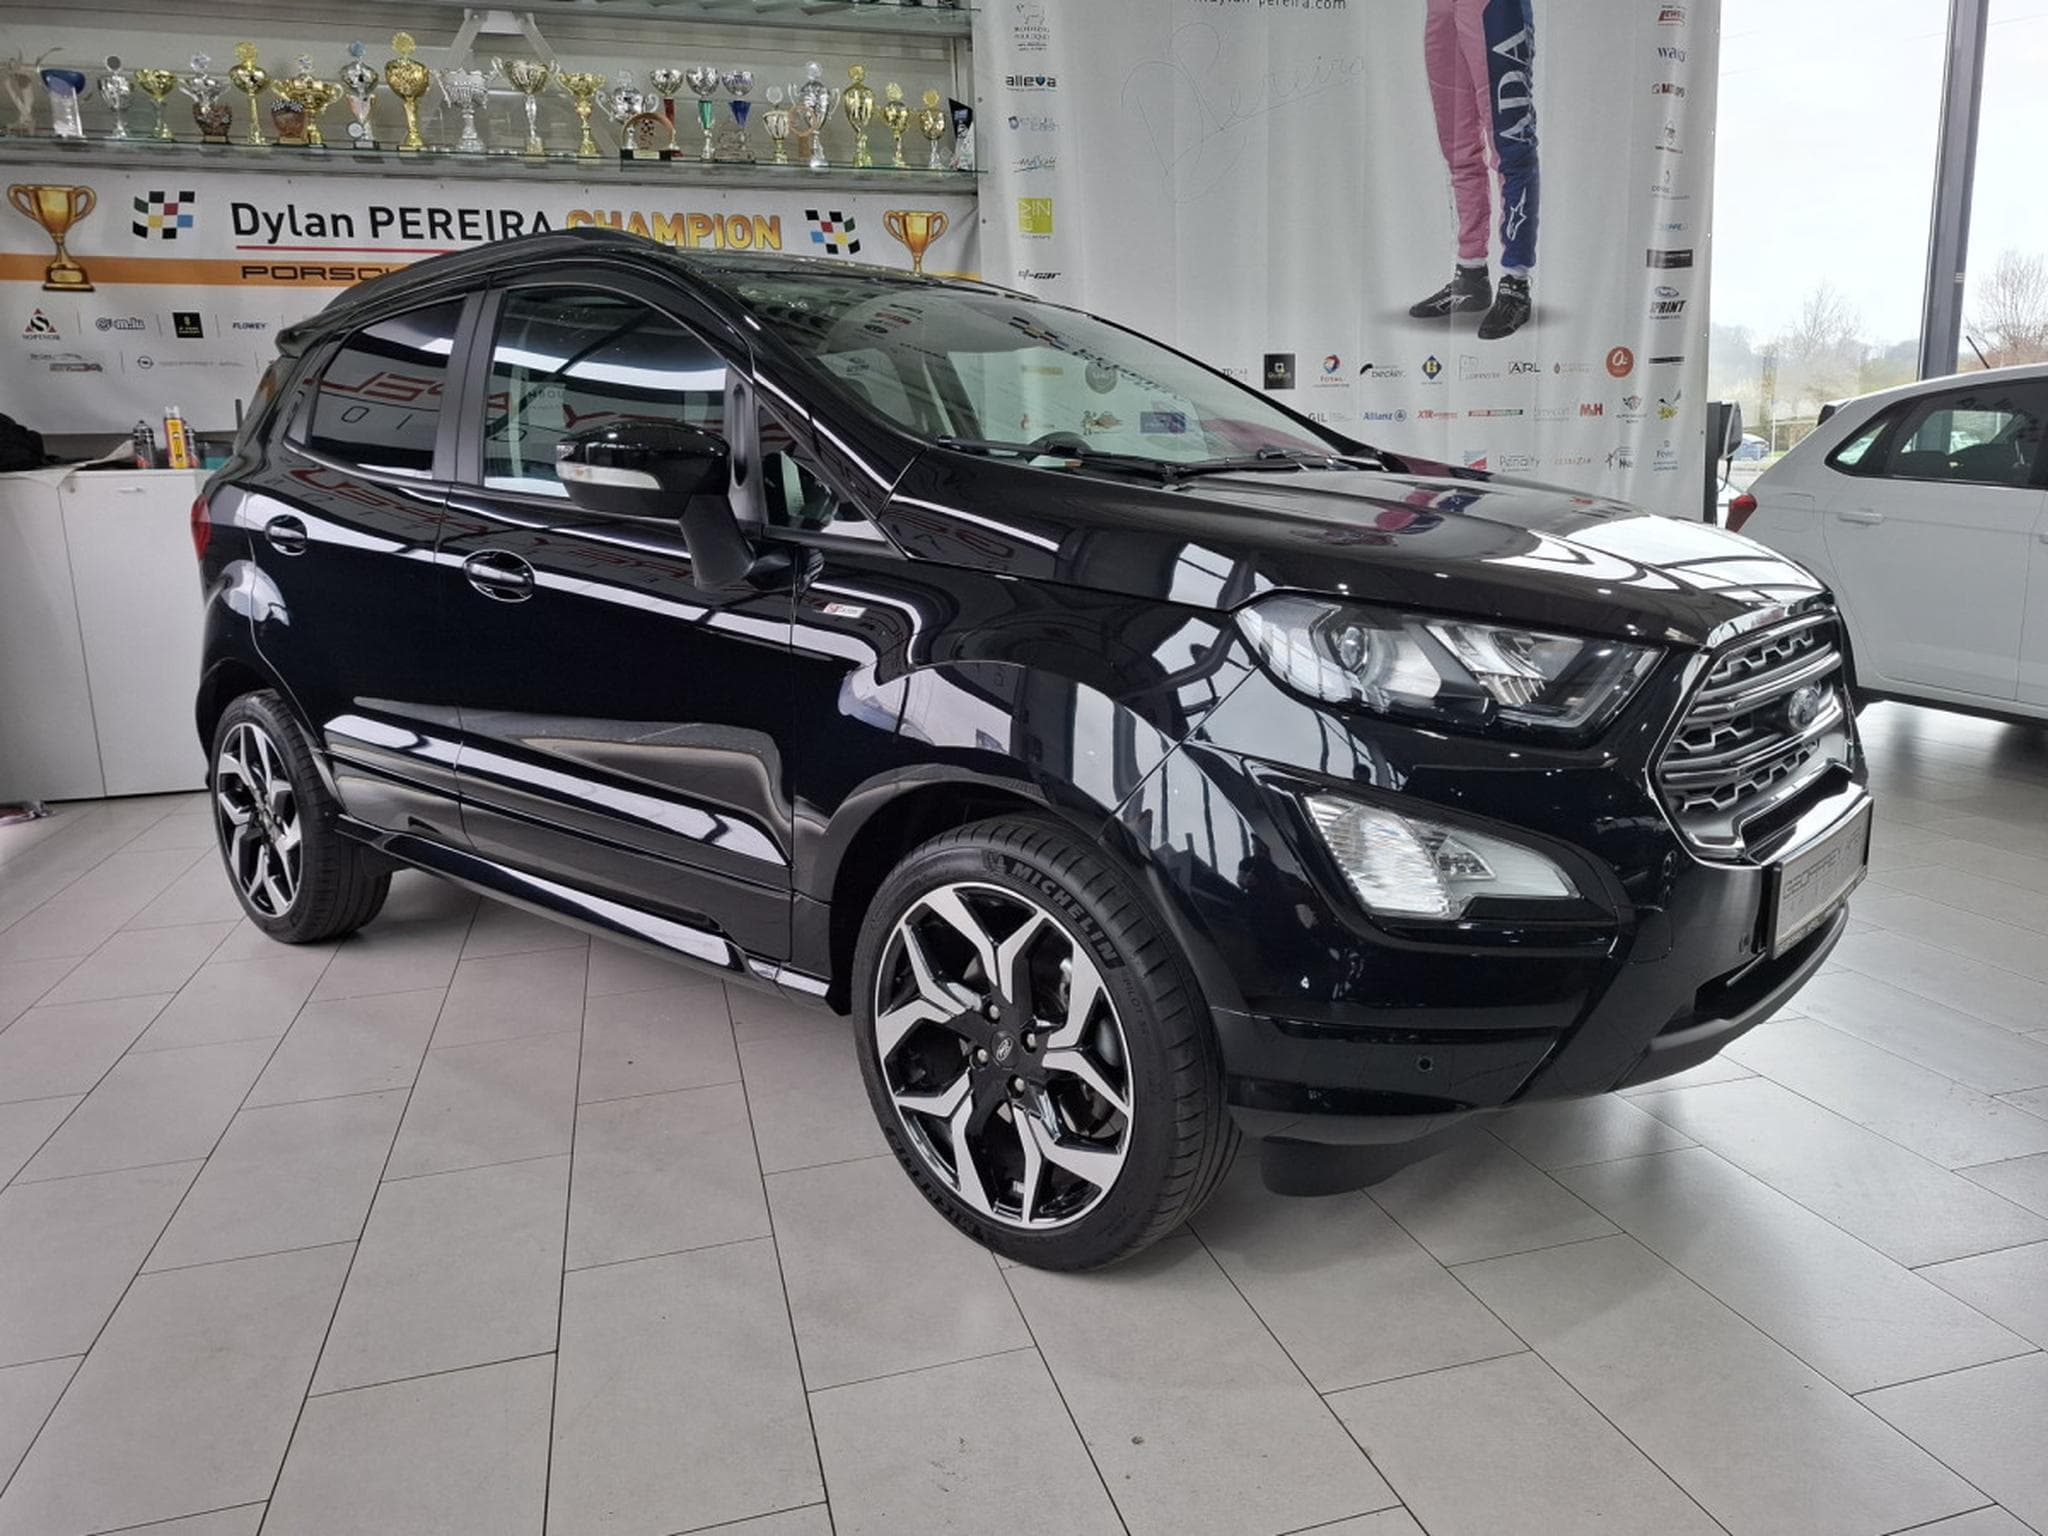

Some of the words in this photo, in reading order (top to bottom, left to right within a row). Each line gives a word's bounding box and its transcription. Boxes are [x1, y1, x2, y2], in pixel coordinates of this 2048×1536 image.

[231, 201, 354, 245] Dylan
[368, 205, 552, 242] PEREIRA
[565, 208, 782, 250] CHAMPION
[241, 265, 391, 281] PORSC
[232, 322, 267, 330] FLOWEY
[1363, 411, 1394, 421] Allianz
[1004, 858, 1119, 966] MICHELIN
